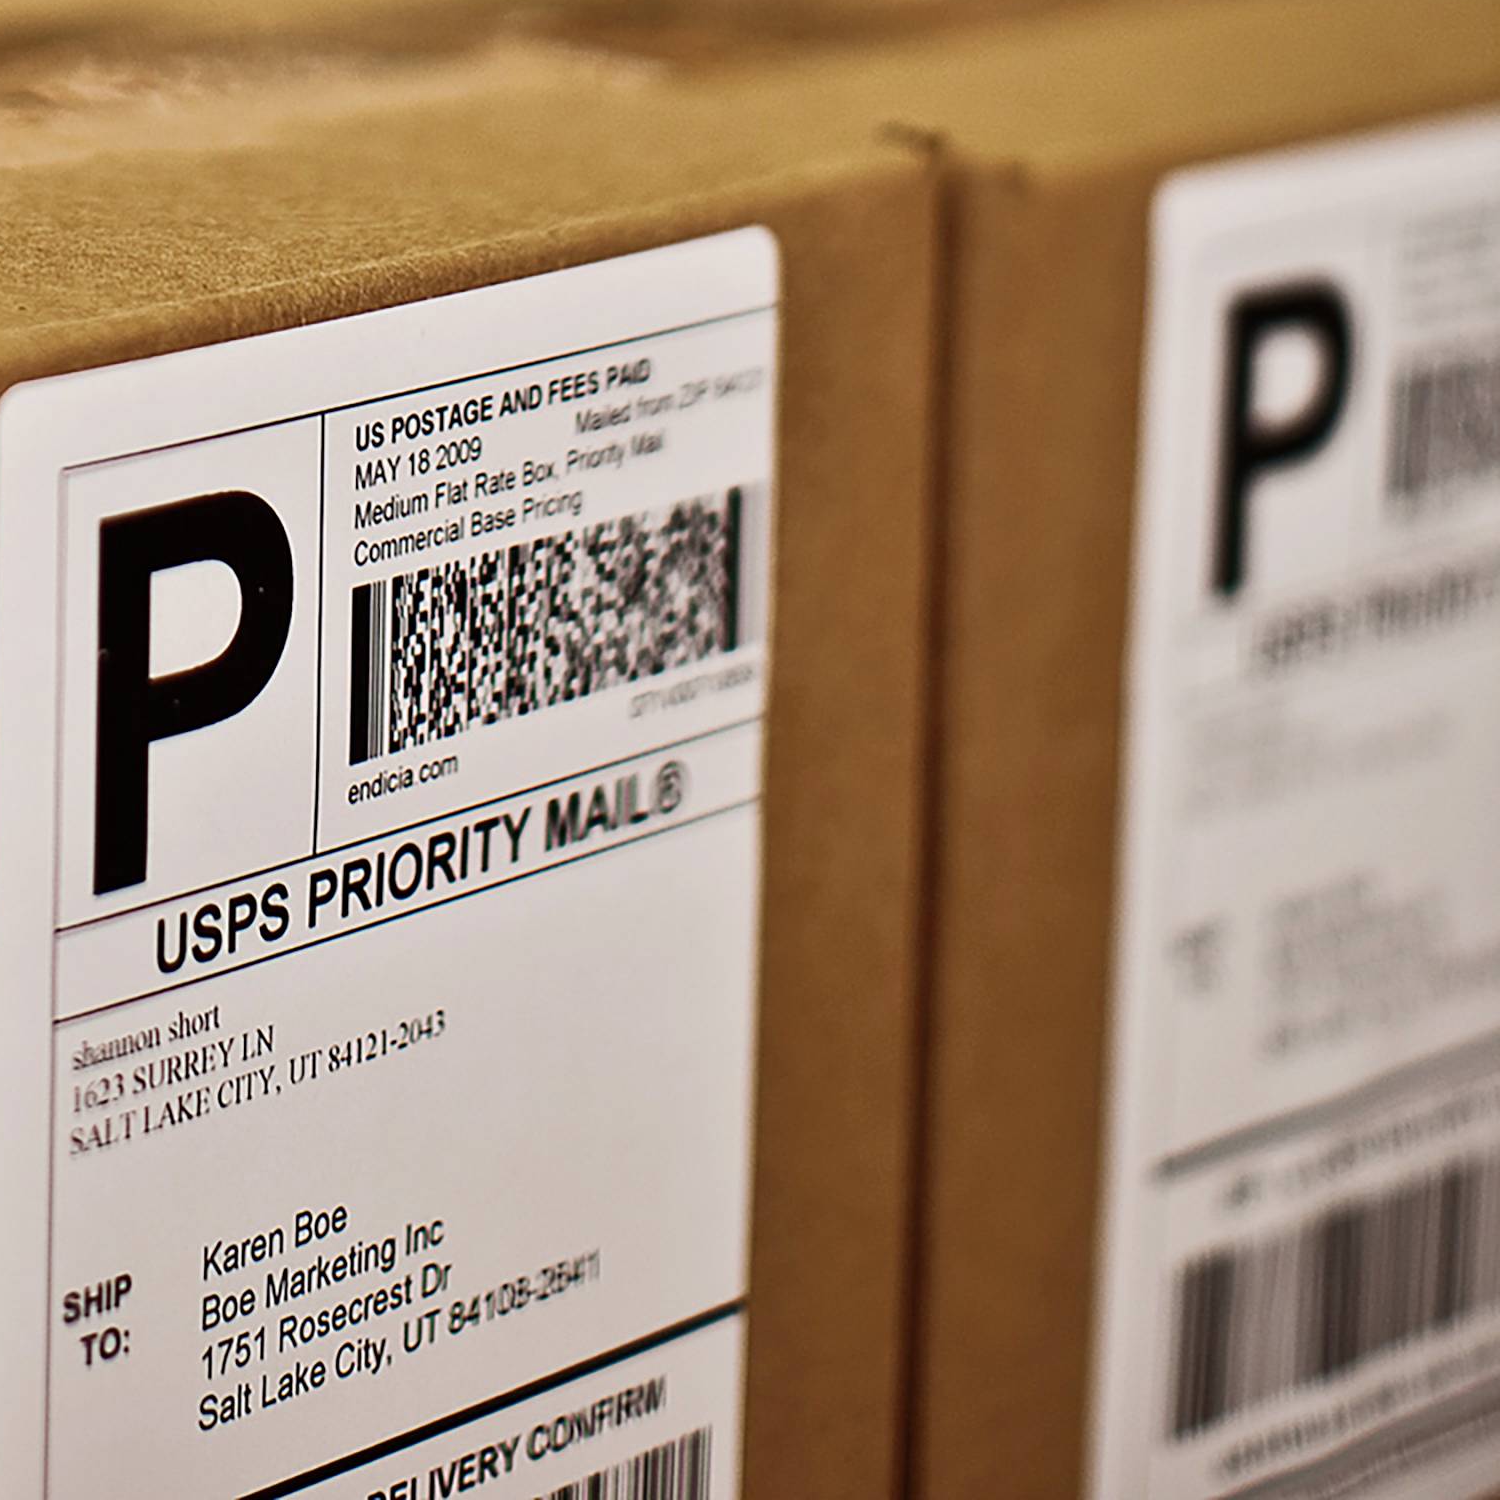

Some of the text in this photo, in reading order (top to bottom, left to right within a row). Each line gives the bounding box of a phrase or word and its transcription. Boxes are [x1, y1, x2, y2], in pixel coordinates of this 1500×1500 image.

[355, 357, 652, 452] US POSTAGE AND FEES PAID
[575, 402, 632, 435] Mailed
[1212, 274, 1357, 600] P
[354, 492, 429, 530] Medium
[435, 478, 468, 509] Flat
[474, 469, 517, 499] Rate
[565, 441, 625, 476] Priority
[355, 436, 483, 491] MAY 18 2009
[354, 489, 583, 567] Commercial Base Pricing
[93, 489, 295, 896] P
[348, 754, 460, 805] endicia.com
[156, 882, 290, 974] USPS
[308, 806, 532, 928] PRIORITY
[69, 1008, 446, 1157] SALT LAKE CITY, UT 84121-2043
[72, 1004, 221, 1071] shannon short
[72, 1024, 276, 1114] 1623 SURREY LN
[201, 1217, 446, 1332] Boe Marketing Inc
[202, 1205, 349, 1281] Karen Boe
[62, 1273, 134, 1324] SHIP
[200, 1261, 453, 1380] 1751 Rosecrest Dr
[78, 1326, 131, 1368] TO:
[198, 1382, 253, 1432] Salt
[260, 1359, 328, 1410] Lake
[334, 1335, 393, 1380] City,
[403, 1309, 441, 1354] UT
[366, 1373, 667, 1500] ELIVERY CONFIRM
